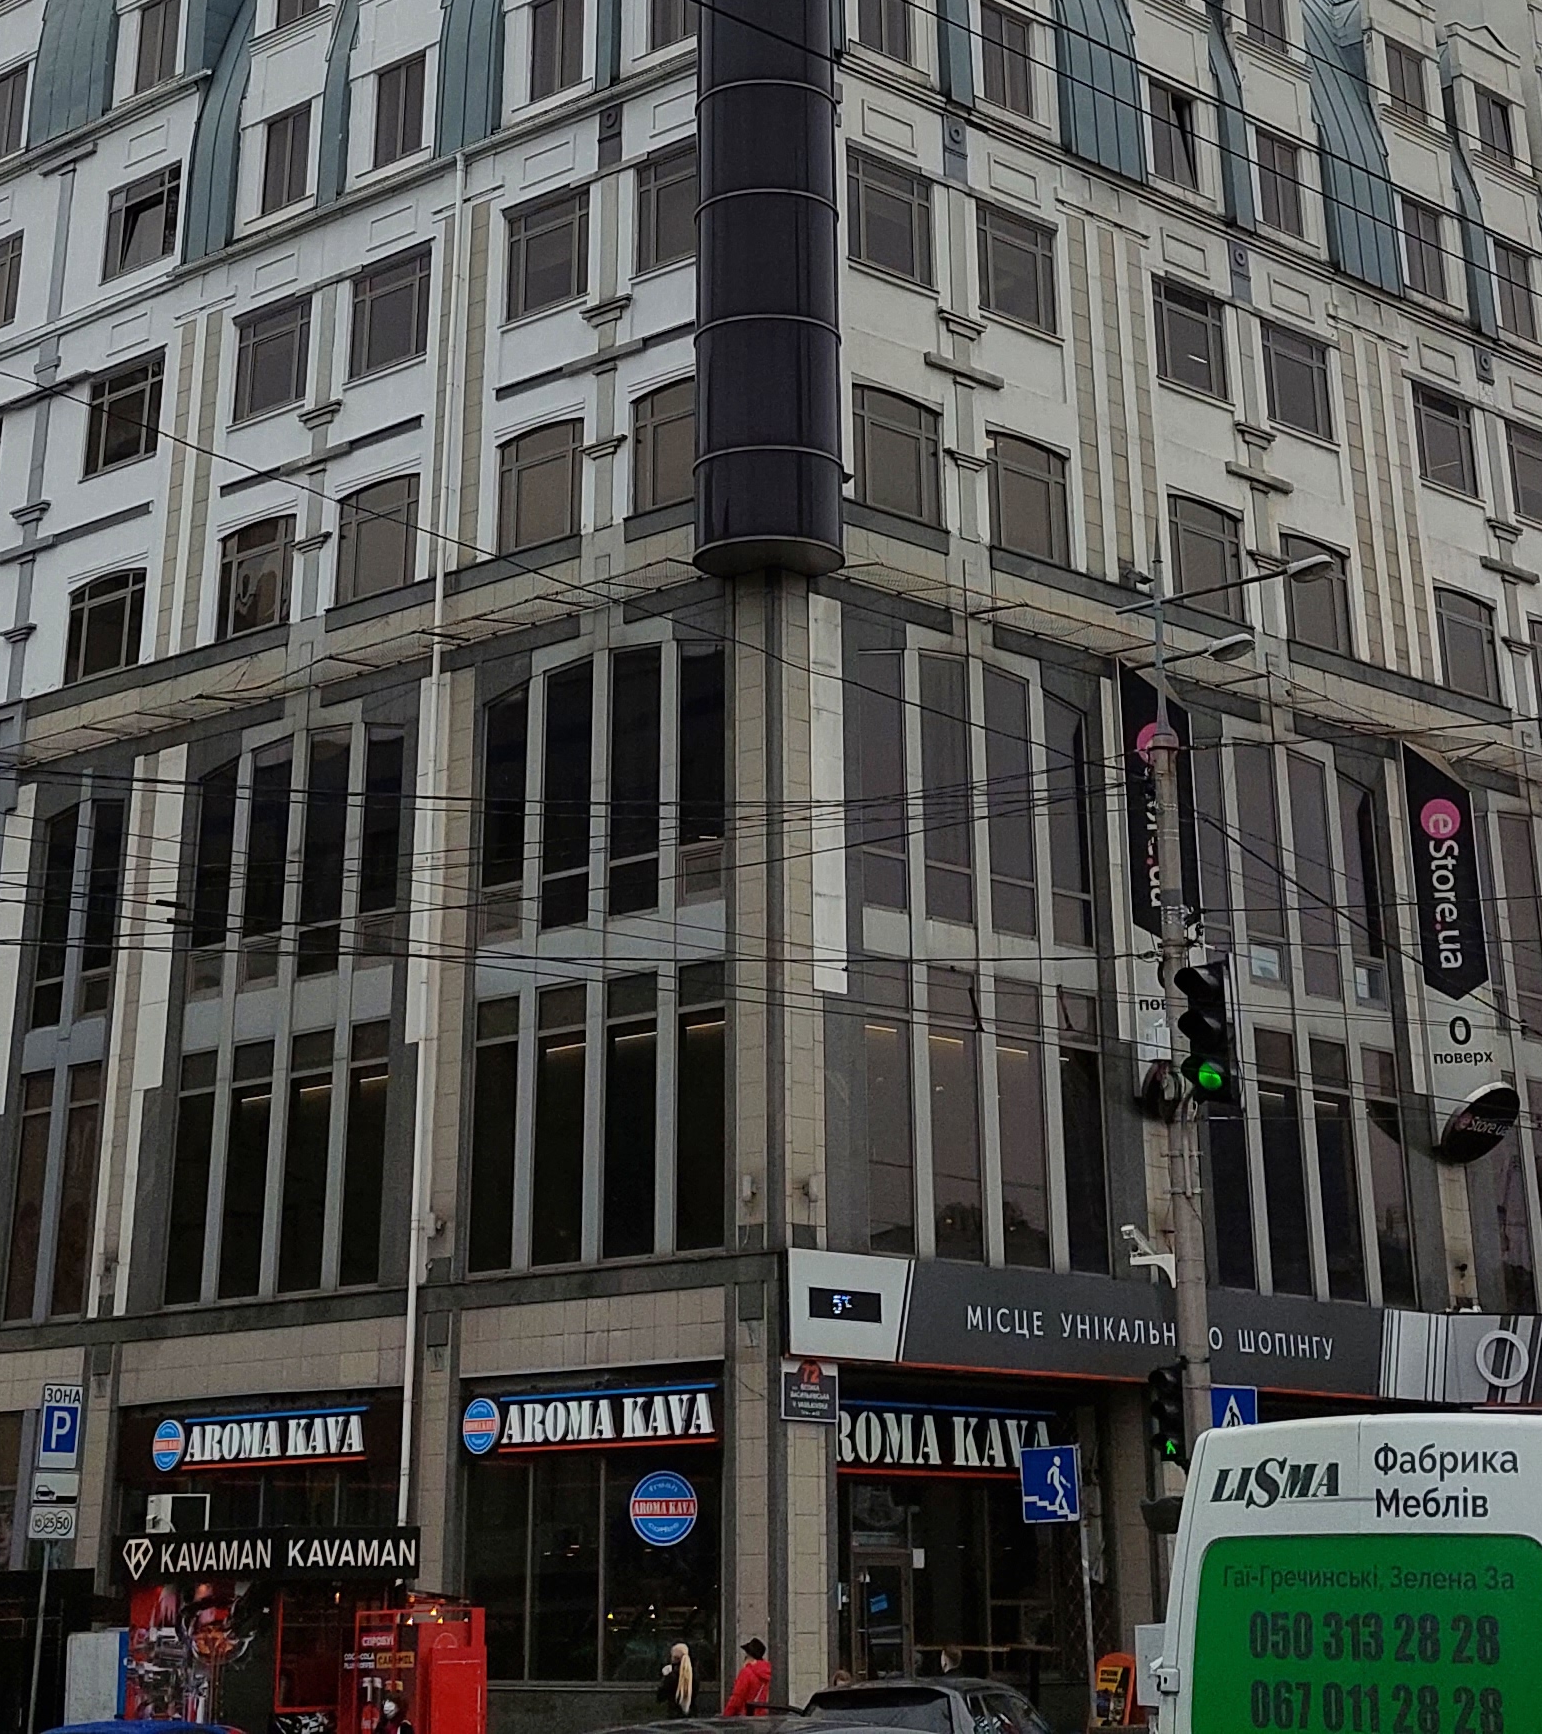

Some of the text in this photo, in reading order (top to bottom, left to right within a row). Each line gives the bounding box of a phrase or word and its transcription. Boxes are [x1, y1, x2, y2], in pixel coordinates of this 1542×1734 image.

[1429, 813, 1463, 969] eStore.ua
[1433, 1051, 1493, 1065] поверх
[967, 1305, 1333, 1360] МІСЦЕ УНІКАЛЬНО ШОПІНГУ
[45, 1388, 82, 1404] ЗОНА
[184, 1415, 365, 1462] AROMA KAVA
[501, 1393, 715, 1444] AROMA KAVA
[837, 1411, 942, 1465] ROMA
[1209, 1457, 1340, 1509] LISMA
[1373, 1443, 1519, 1482] Фабрика
[44, 1518, 55, 1528] 25
[56, 1516, 69, 1530] 50
[633, 1501, 695, 1515] AROMA KAVA
[1375, 1486, 1490, 1518] Меблів
[161, 1538, 416, 1573] KAVAMAN KAVAMAN
[1390, 1567, 1477, 1591] Зелена
[1249, 1611, 1500, 1665] 050 313 28 28
[1251, 1680, 1504, 1734] 067 011 28 28
